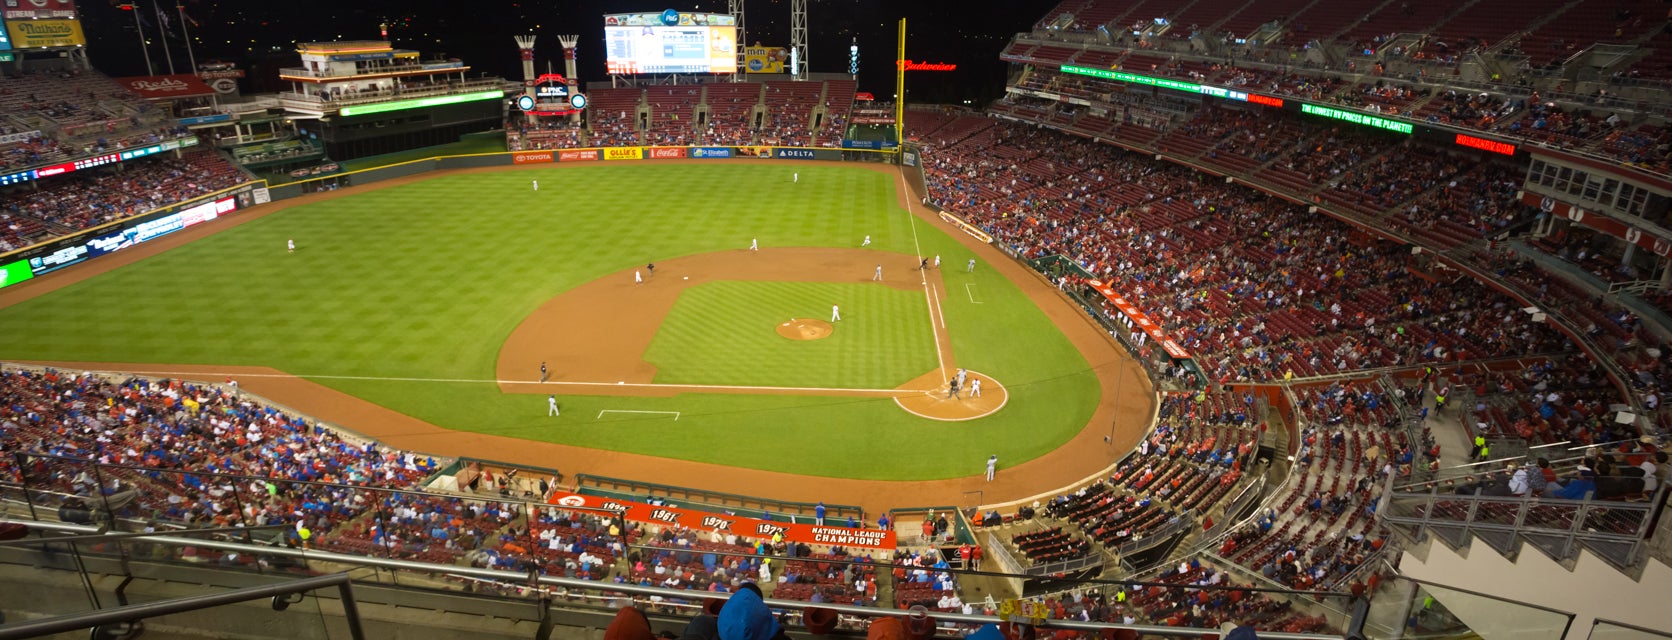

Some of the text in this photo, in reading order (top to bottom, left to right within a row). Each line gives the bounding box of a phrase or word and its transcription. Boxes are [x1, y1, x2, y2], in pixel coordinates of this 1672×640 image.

[7, 10, 35, 18] STREAM
[896, 60, 957, 71] Budweiser
[131, 78, 189, 92] Reds
[1302, 103, 1312, 113] THE
[1312, 105, 1334, 118] LOWEST
[1333, 109, 1343, 119] RV
[1341, 111, 1362, 124] PRICES
[1362, 115, 1371, 126] ON
[1371, 117, 1383, 128] THE
[610, 148, 637, 157] OLLIE'S
[652, 509, 676, 522] 1961
[704, 517, 728, 530] 1970
[811, 527, 887, 539] NATIONAL LEAGUE
[815, 534, 881, 546] CHAMPIONS
